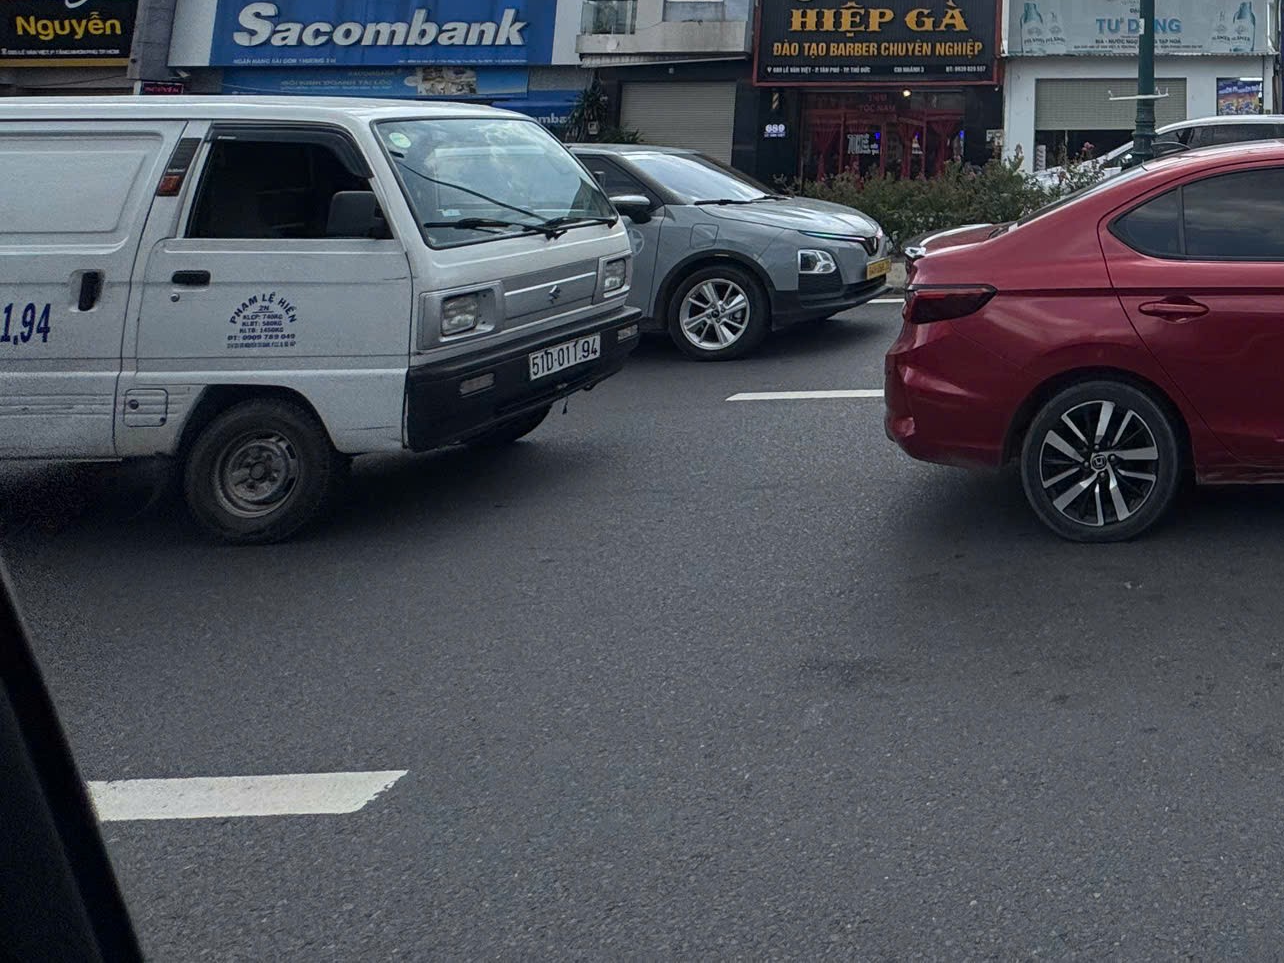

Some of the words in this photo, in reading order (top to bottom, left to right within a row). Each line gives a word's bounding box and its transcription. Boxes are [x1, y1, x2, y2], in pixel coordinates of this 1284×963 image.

[16, 11, 122, 40] Nguyễn
[233, 2, 527, 47] Sacombank
[788, 0, 895, 38] HIỆP
[904, 0, 969, 31] GÀ
[1128, 18, 1182, 34] DNG
[773, 39, 798, 56] ĐÀO
[803, 42, 826, 59] TẠO
[830, 42, 878, 56] BARBER
[881, 39, 931, 56] CHUYÊN
[936, 39, 983, 59] NGHIỆP
[532, 337, 598, 376] 51D-011.94
